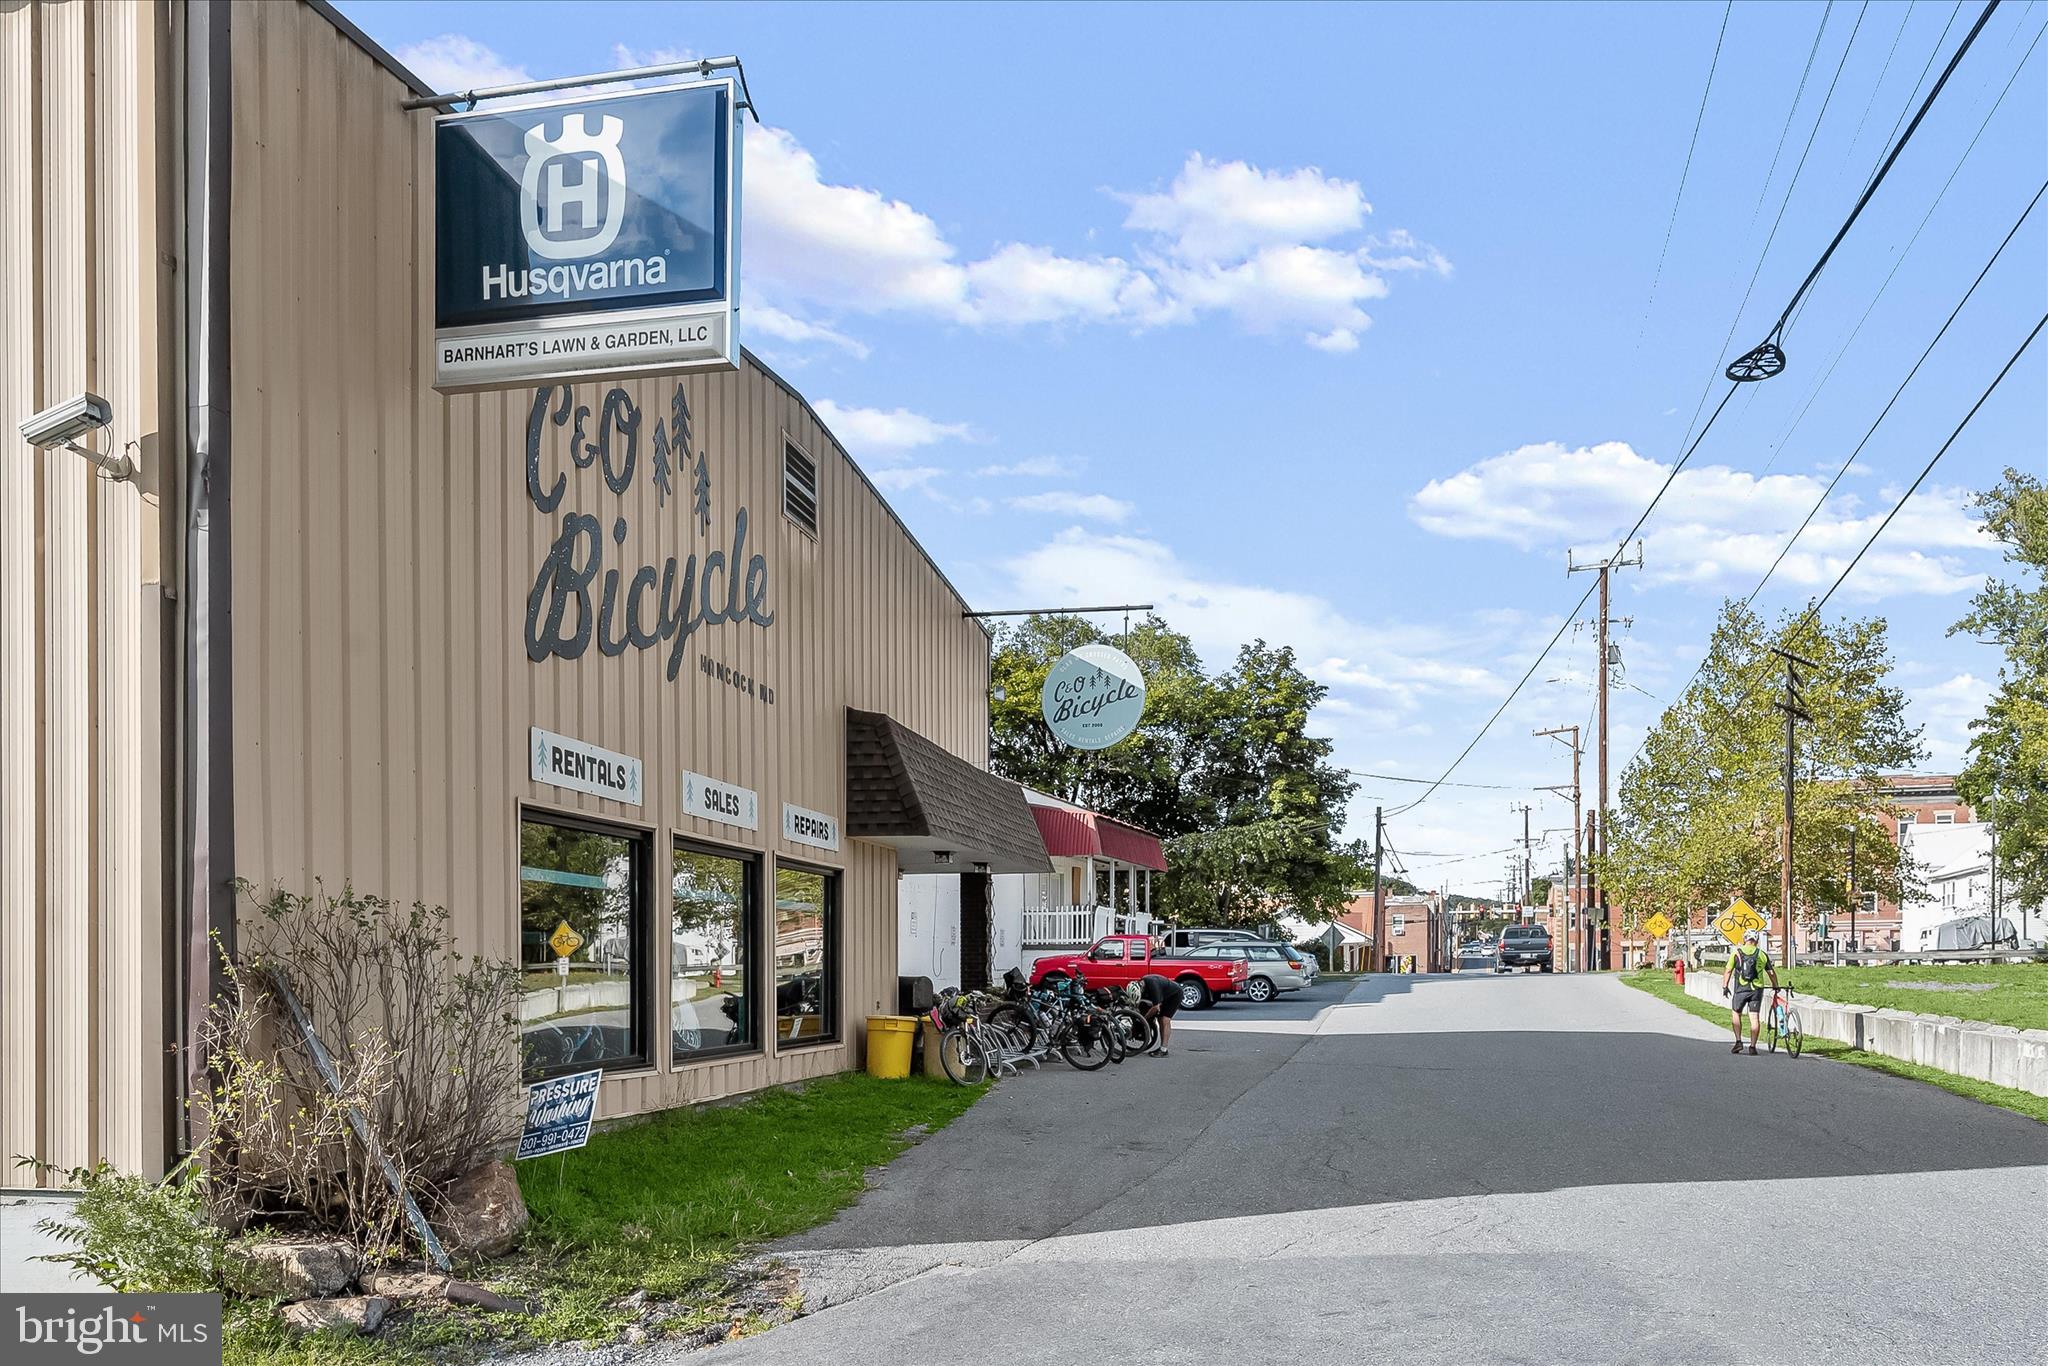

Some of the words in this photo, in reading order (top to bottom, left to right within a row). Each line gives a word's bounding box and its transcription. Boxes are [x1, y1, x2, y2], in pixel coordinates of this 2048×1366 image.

[547, 158, 599, 233] H
[482, 256, 666, 300] Husqvarna
[444, 342, 538, 364] BARNHART'S
[542, 337, 586, 355] LAWN
[590, 336, 601, 350] &
[605, 329, 674, 350] GARDEN,
[678, 326, 708, 343] LLC
[527, 383, 642, 514] C&O
[525, 506, 774, 682] Bicycle
[700, 654, 755, 698] HANCOCK
[759, 683, 774, 705] MD
[1054, 675, 1087, 703] C&O
[1052, 678, 1139, 724] Bicycle
[551, 745, 626, 791] RENTALS
[704, 786, 740, 817] SALES
[793, 814, 829, 841] REPAIRS
[528, 1095, 592, 1128] Washing
[530, 1076, 598, 1106] PRESSURE
[520, 1125, 587, 1151] 301-991-0472
